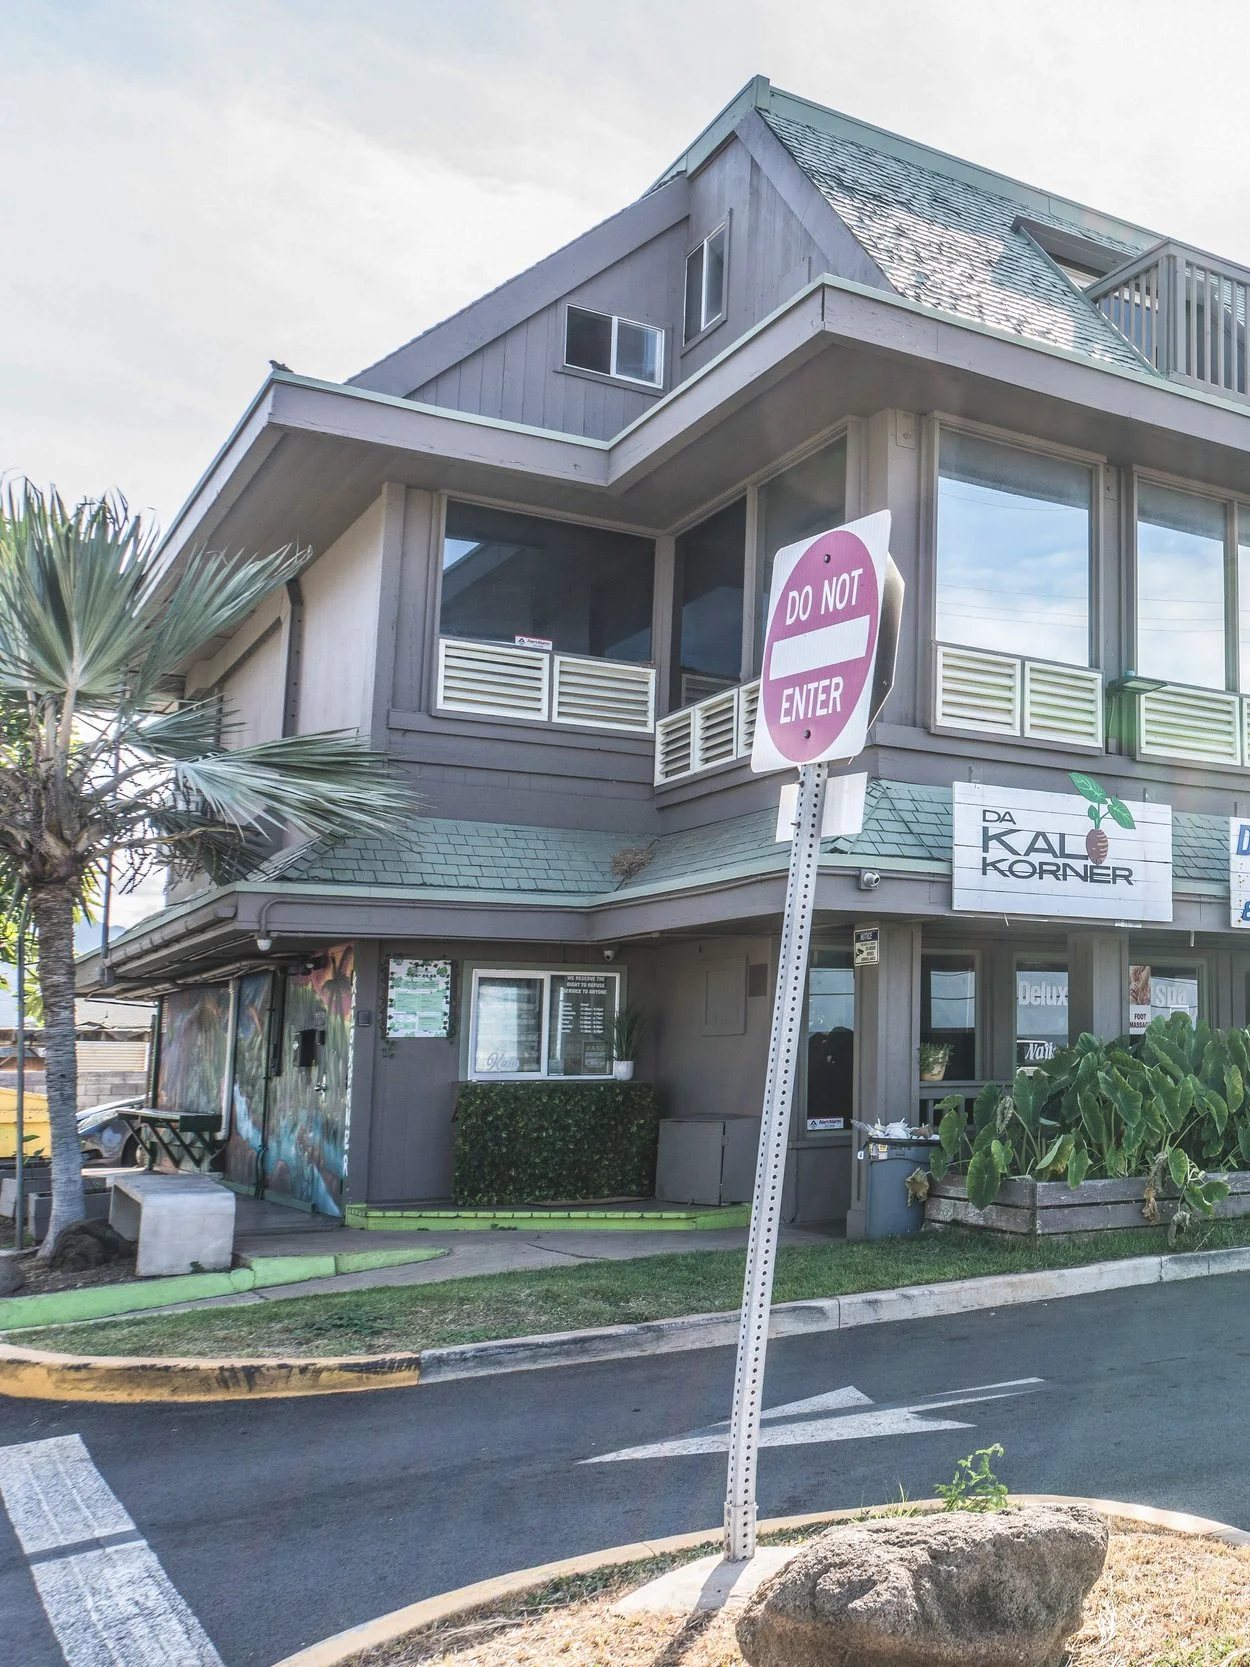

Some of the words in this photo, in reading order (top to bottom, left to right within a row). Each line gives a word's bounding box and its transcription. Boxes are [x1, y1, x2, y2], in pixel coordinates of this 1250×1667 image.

[785, 584, 813, 627] DO
[821, 568, 864, 615] NOT
[779, 676, 844, 724] ENTER
[982, 809, 1017, 825] DA
[981, 857, 1134, 886] KORNER
